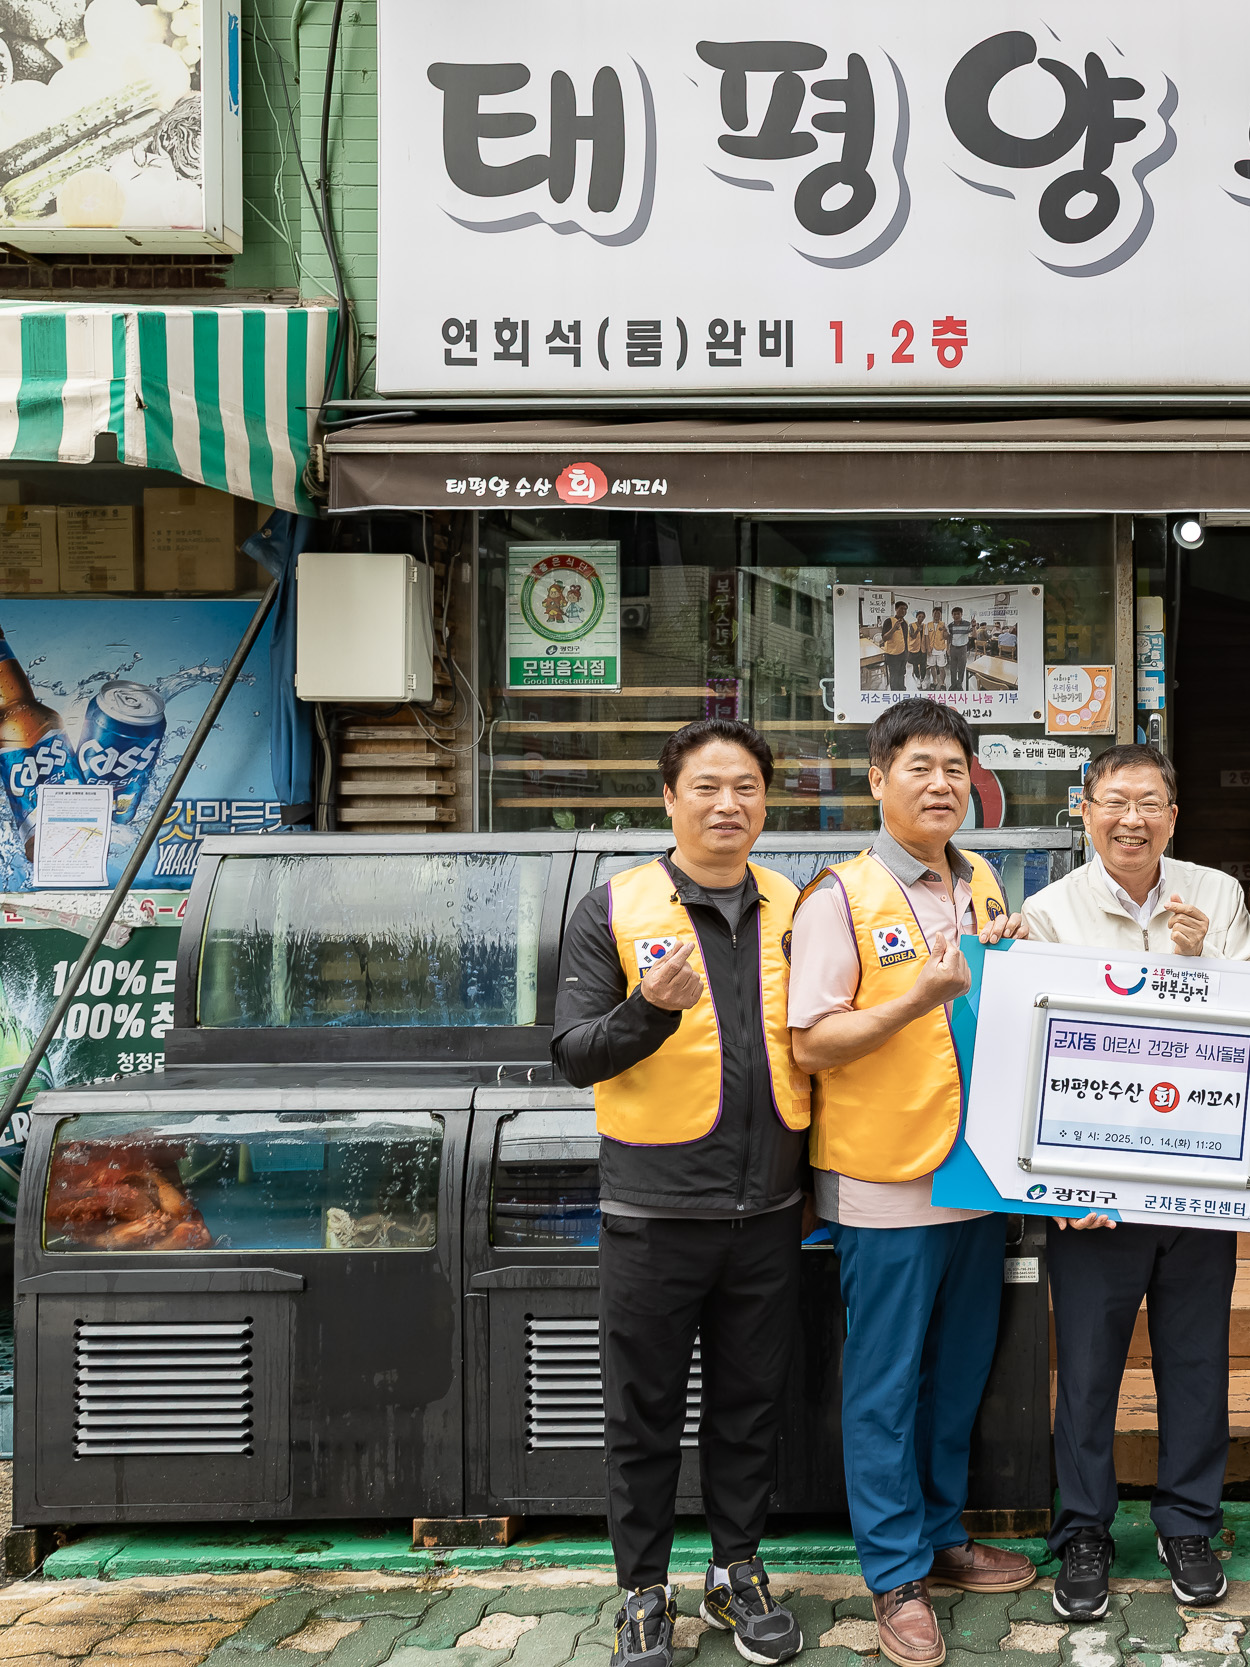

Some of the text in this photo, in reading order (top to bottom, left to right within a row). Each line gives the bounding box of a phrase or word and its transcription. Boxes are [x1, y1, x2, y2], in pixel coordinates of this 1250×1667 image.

[828, 316, 969, 371] 1,2층
[568, 469, 595, 498] 회
[611, 478, 668, 496] 세꼬시
[522, 659, 605, 677] 모범음식점
[523, 677, 605, 685] Good Restaurant
[972, 693, 993, 704] 나눔
[998, 693, 1018, 704] 기부
[1047, 748, 1066, 758] 판매
[879, 950, 916, 967] KOREA
[1151, 980, 1208, 1002] 행복광진
[1054, 1030, 1245, 1064] 군자동 어르신 건강한 식사돌봄
[1050, 1077, 1241, 1109] 태평양수산 회 세꼬시
[1105, 1132, 1134, 1144] 2025.
[1139, 1135, 1154, 1146] 10.
[1160, 1137, 1191, 1150] 14.(화)
[1196, 1139, 1222, 1151] 11:20
[1052, 1187, 1246, 1217] 광진구 군자동주민센터
